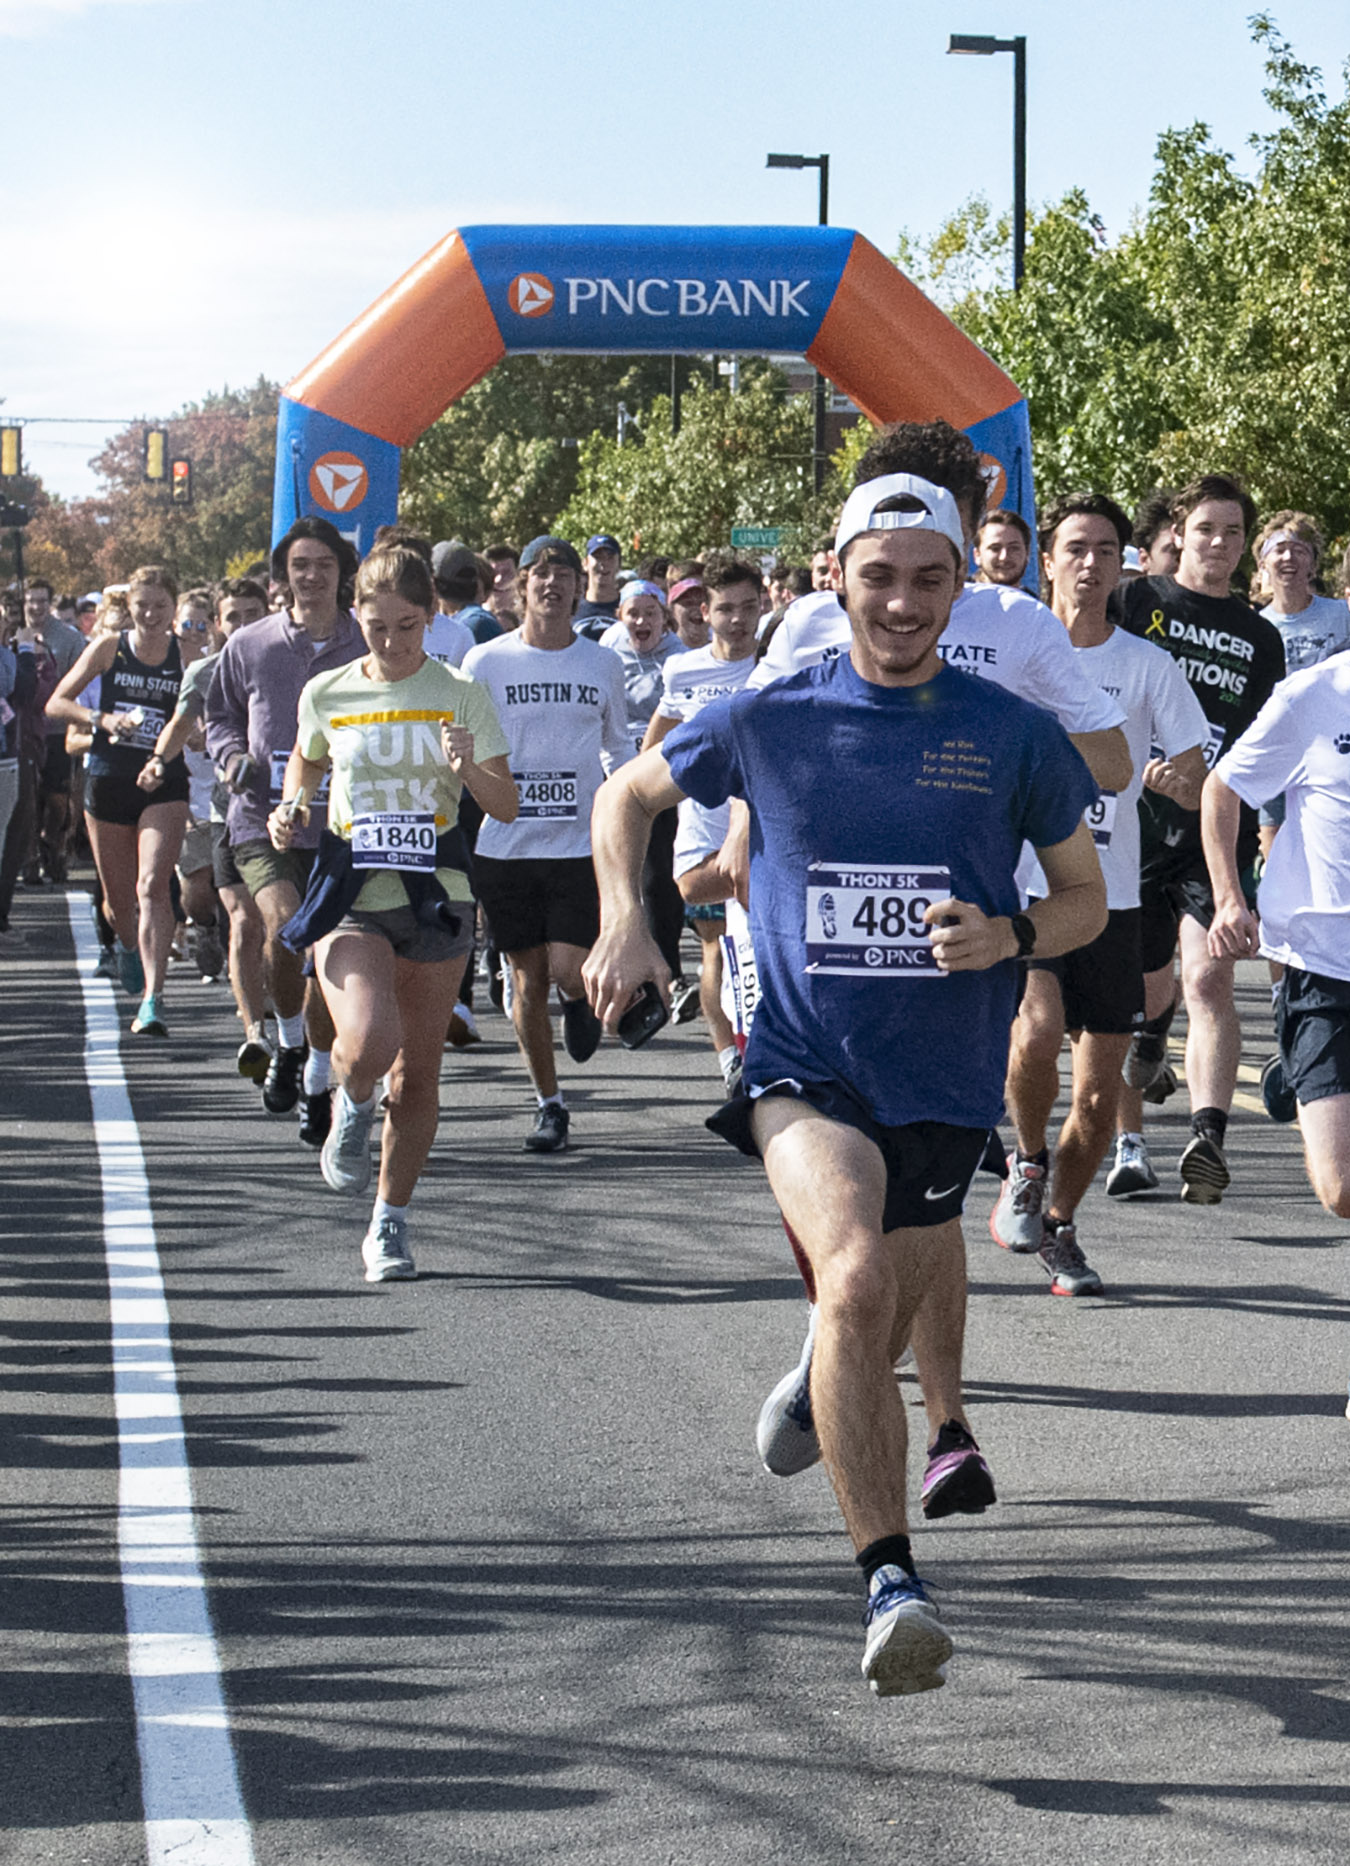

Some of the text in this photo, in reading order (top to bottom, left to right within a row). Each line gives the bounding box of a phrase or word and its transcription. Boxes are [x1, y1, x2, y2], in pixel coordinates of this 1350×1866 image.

[1169, 619, 1255, 662] DANCER
[937, 644, 997, 665] TATE
[114, 671, 146, 689] PENN
[147, 678, 179, 694] STATE
[1175, 656, 1249, 696] ATIONS
[505, 683, 599, 706] RUSTIN XC
[525, 782, 576, 803] 4808
[373, 826, 434, 850] 1840
[837, 873, 919, 889] THON 5K
[852, 895, 933, 938] 489
[886, 949, 926, 965] PNC
